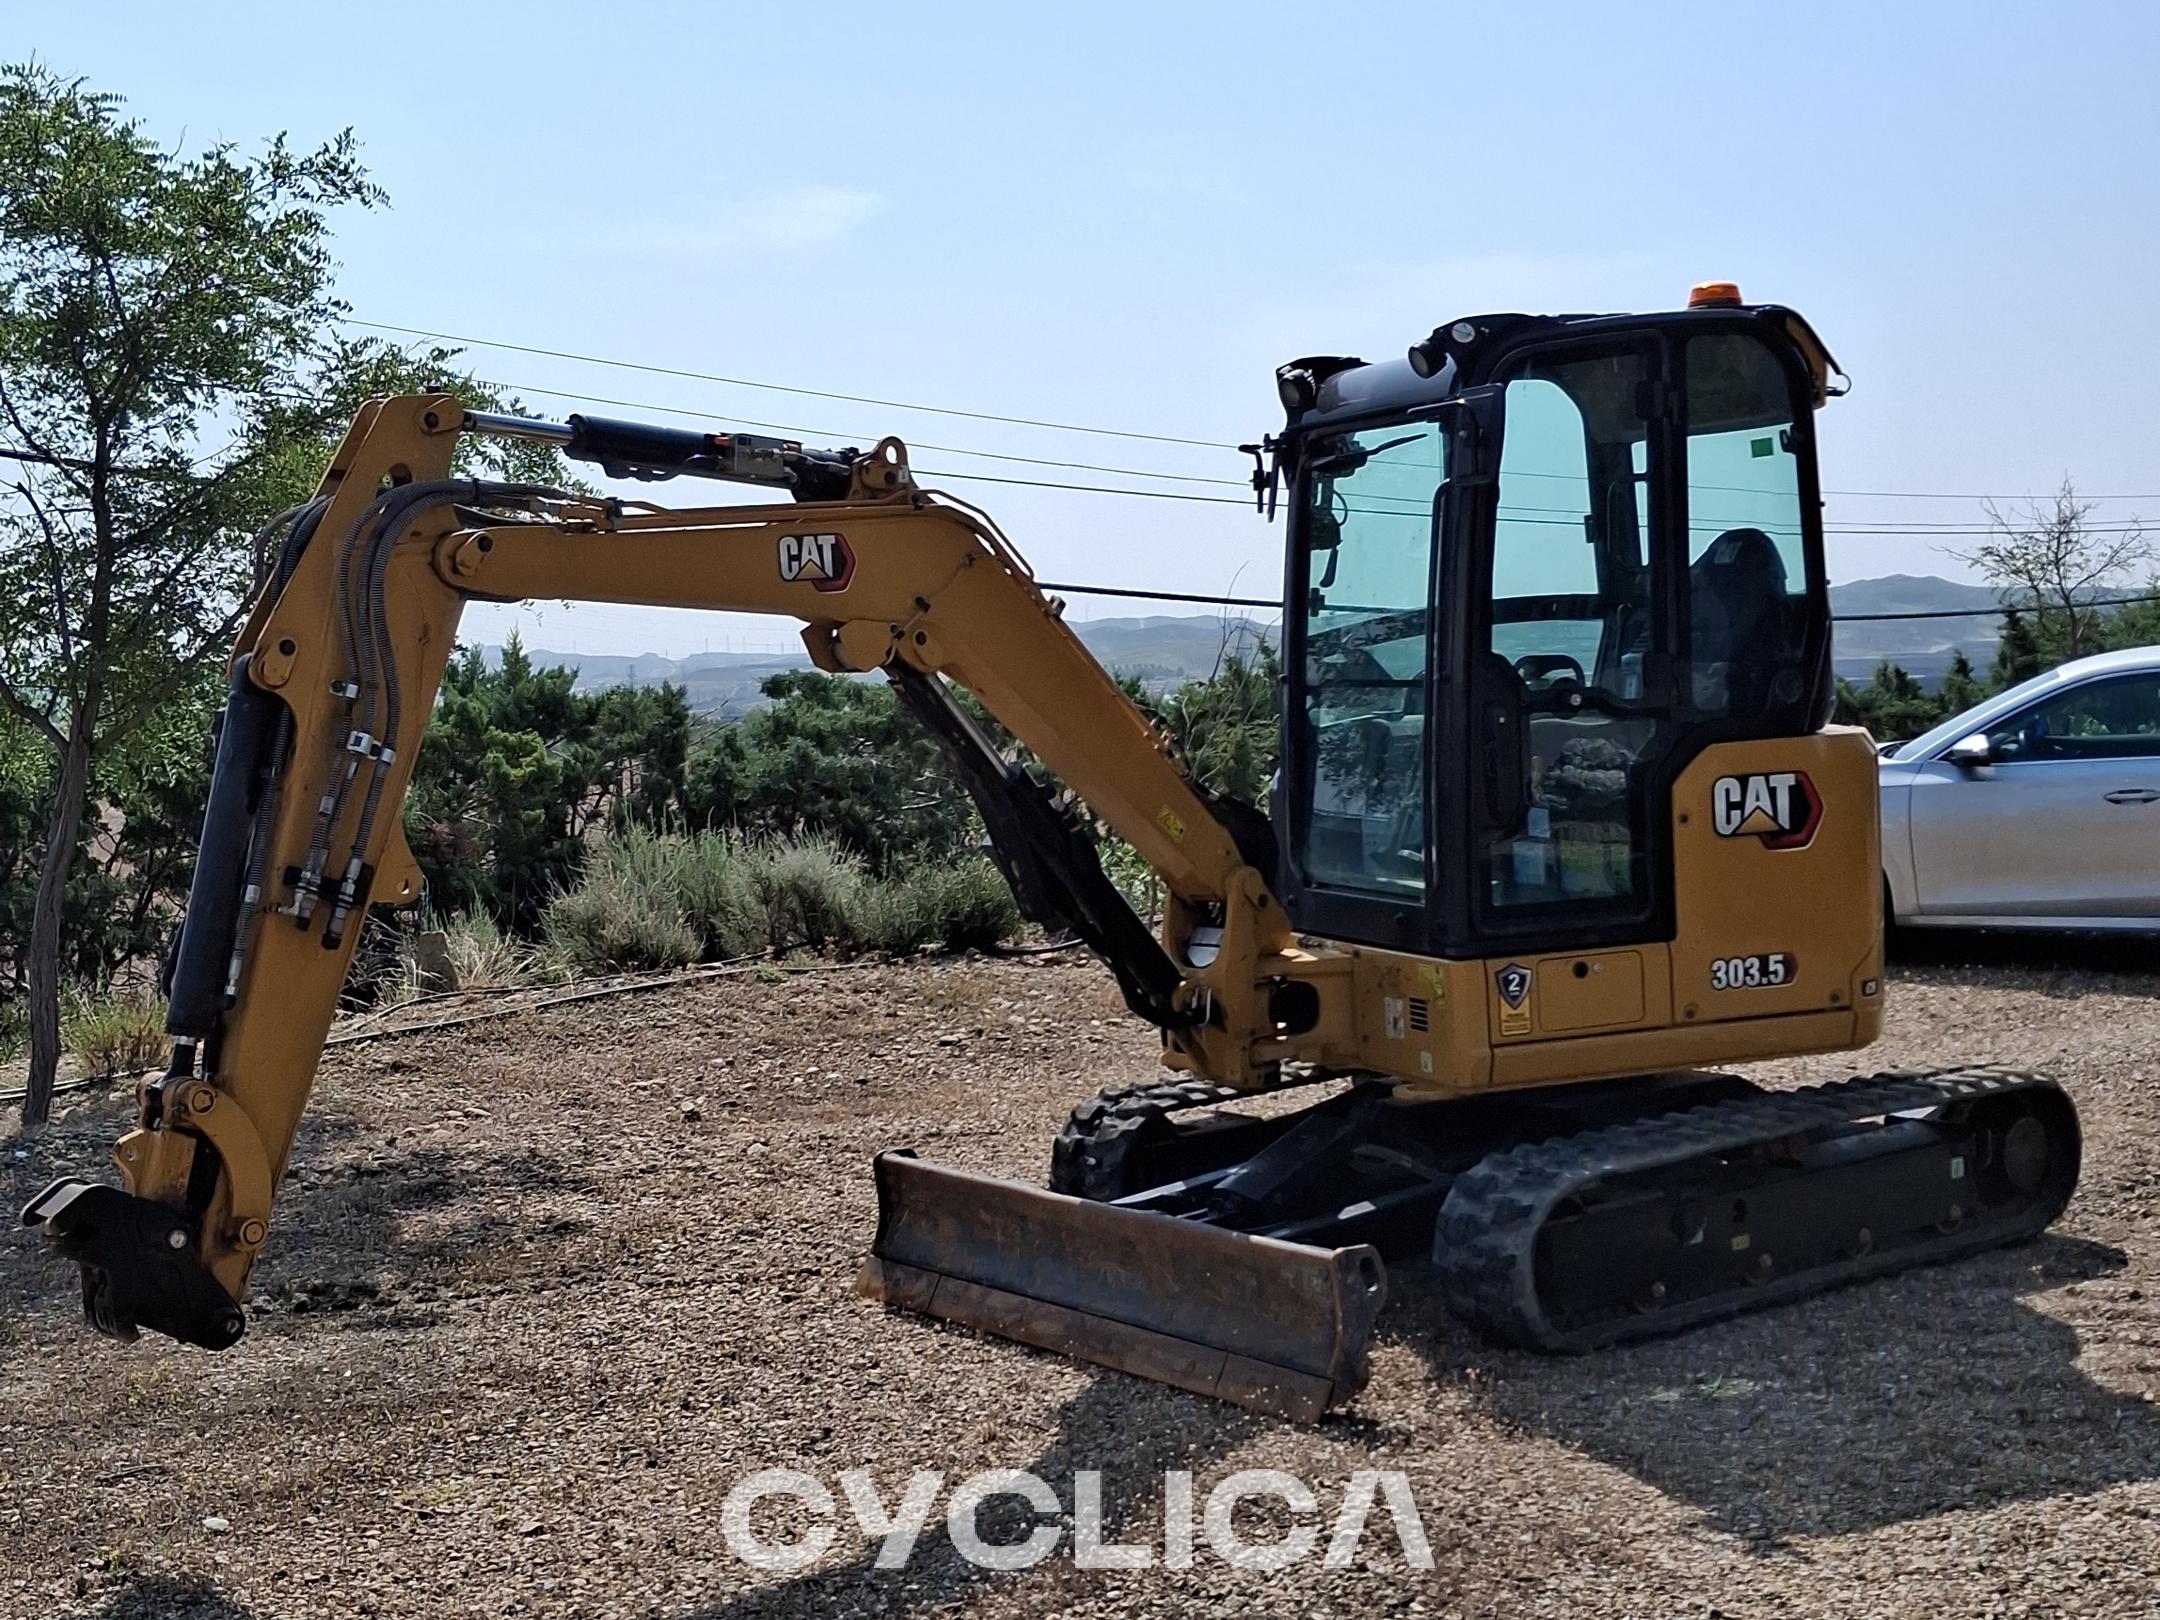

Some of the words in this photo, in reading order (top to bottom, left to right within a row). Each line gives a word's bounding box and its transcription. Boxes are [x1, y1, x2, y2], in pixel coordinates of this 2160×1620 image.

[779, 534, 836, 580] CAT
[1713, 773, 1797, 835] CAT
[1508, 973, 1521, 992] 2
[1711, 954, 1786, 990] 303.5
